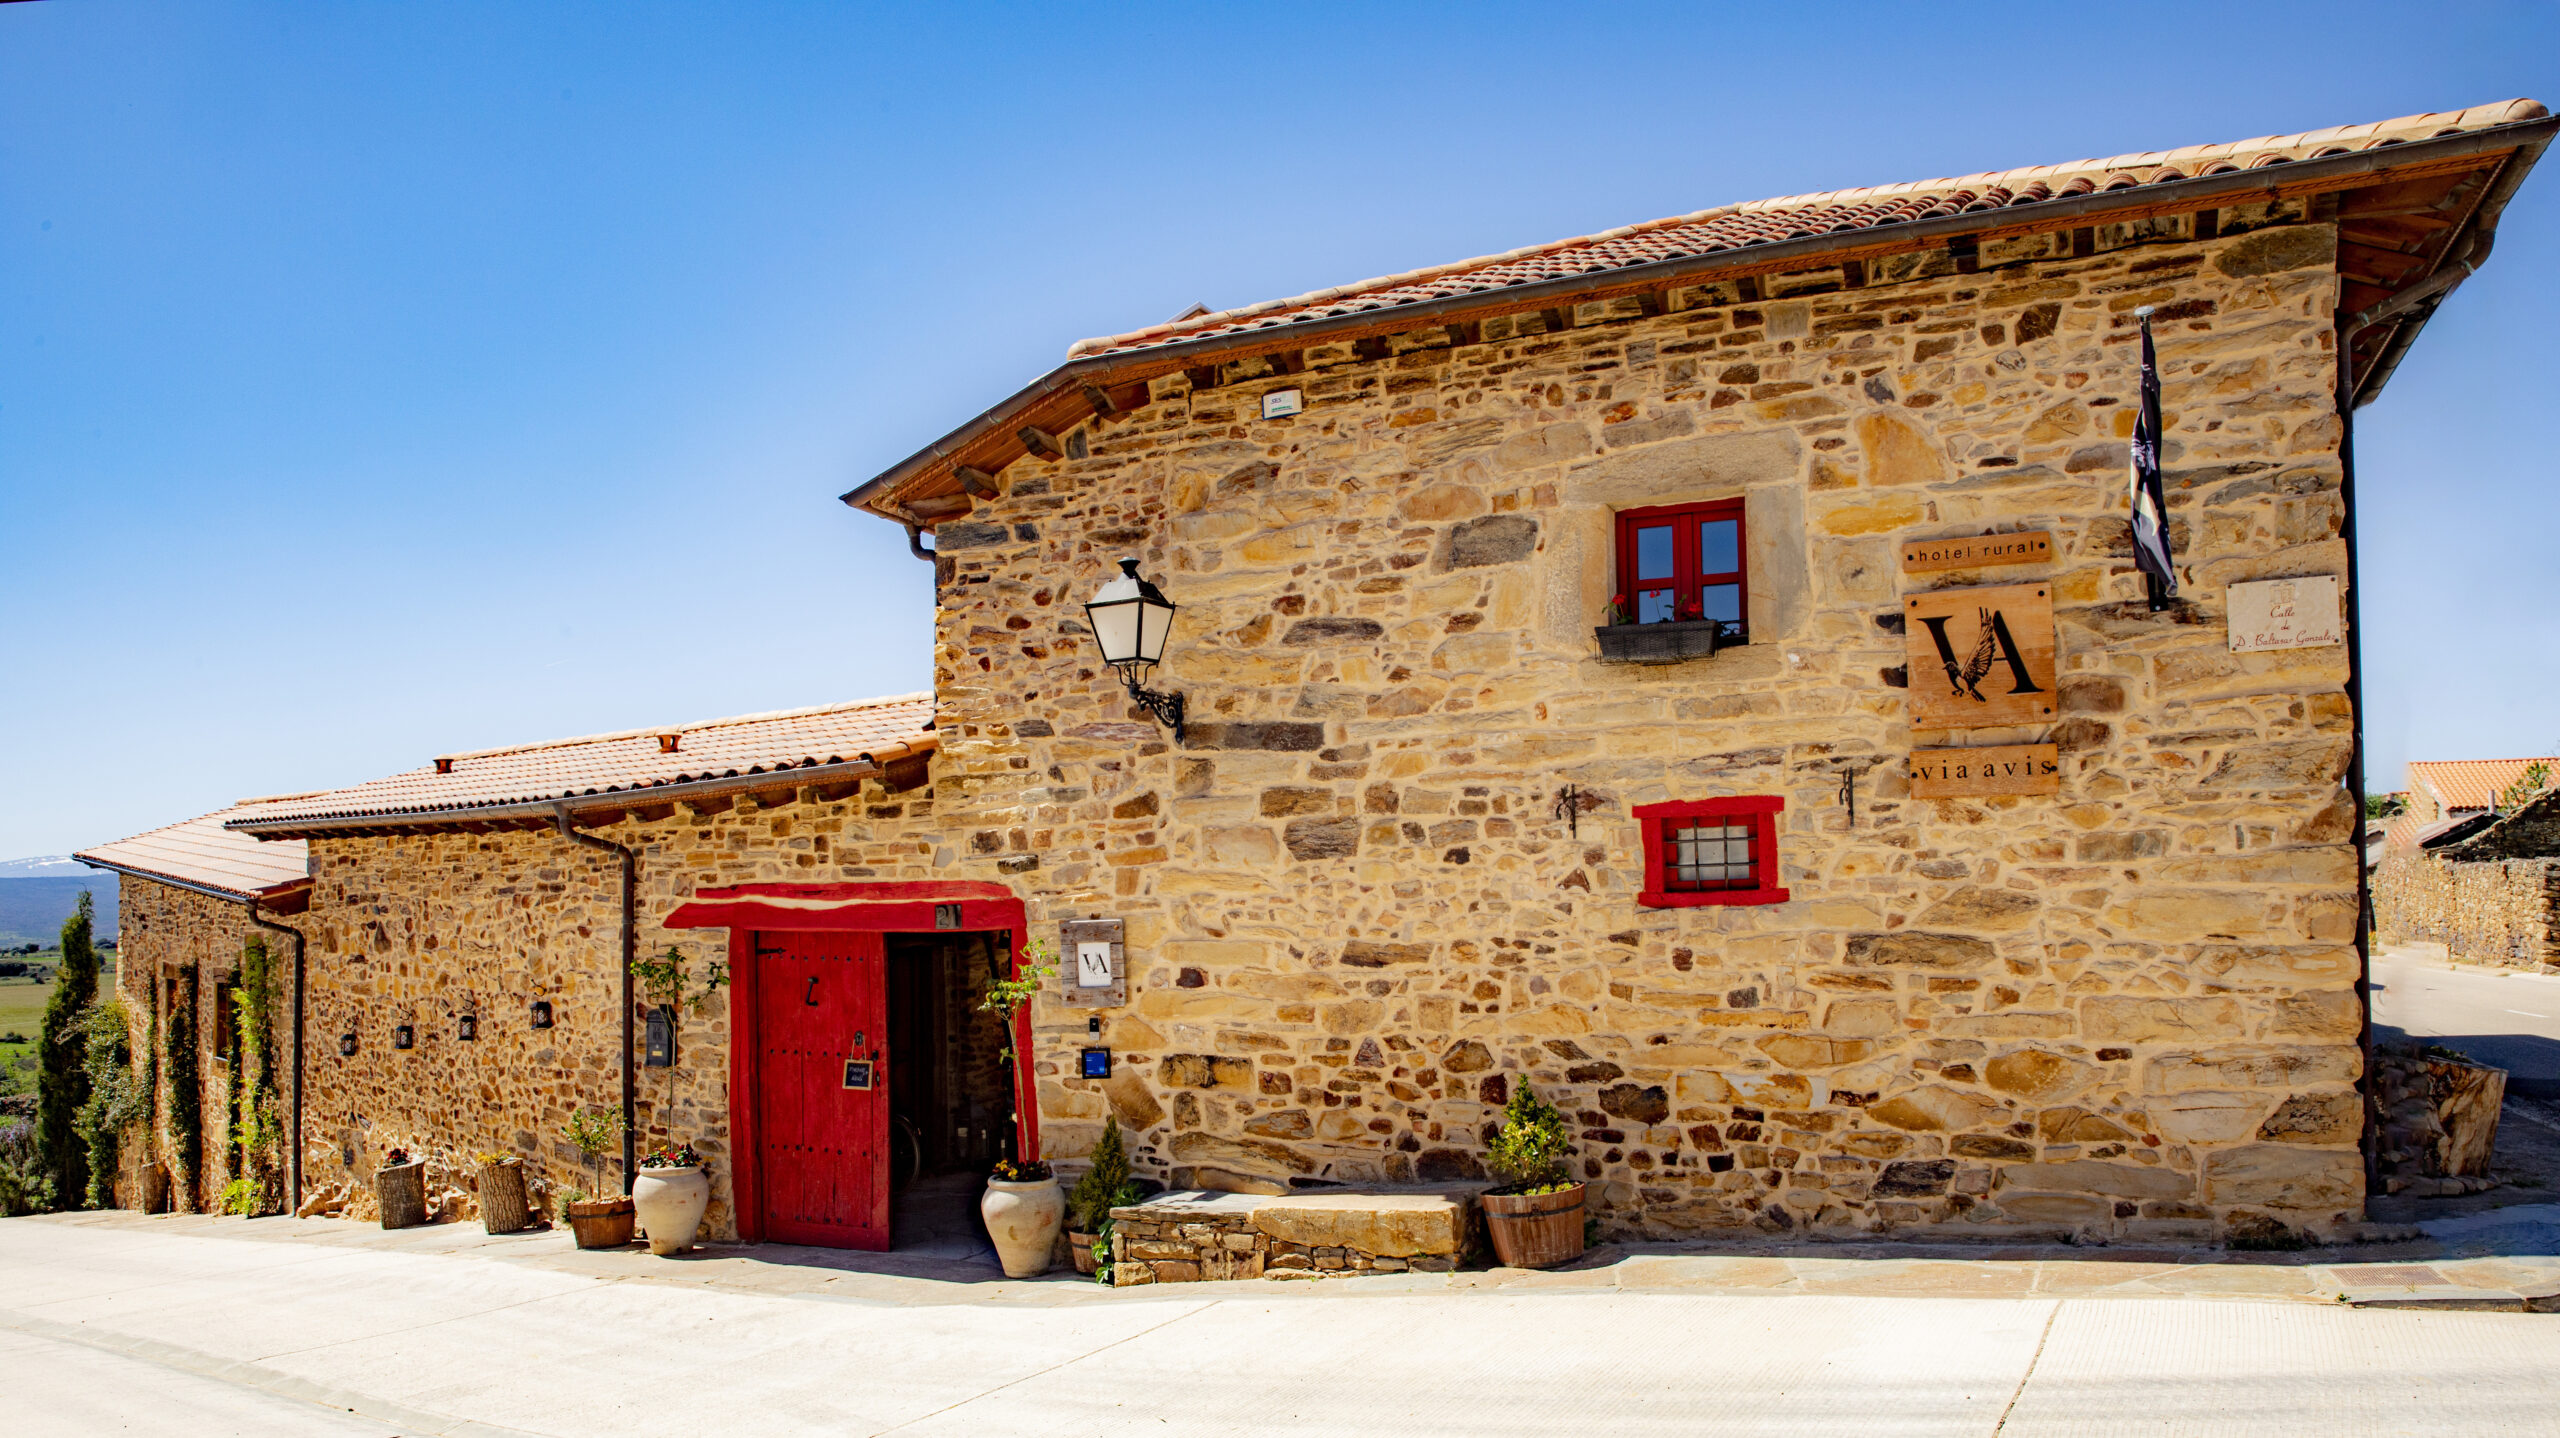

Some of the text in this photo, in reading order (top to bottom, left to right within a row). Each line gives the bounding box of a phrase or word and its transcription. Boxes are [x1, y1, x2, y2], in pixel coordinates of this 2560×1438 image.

[1918, 540, 2035, 562] hotel rural
[2270, 605, 2295, 618] Calle
[2281, 620, 2291, 631] de
[2255, 632, 2294, 647] Baltasar
[1920, 755, 2051, 781] via avis
